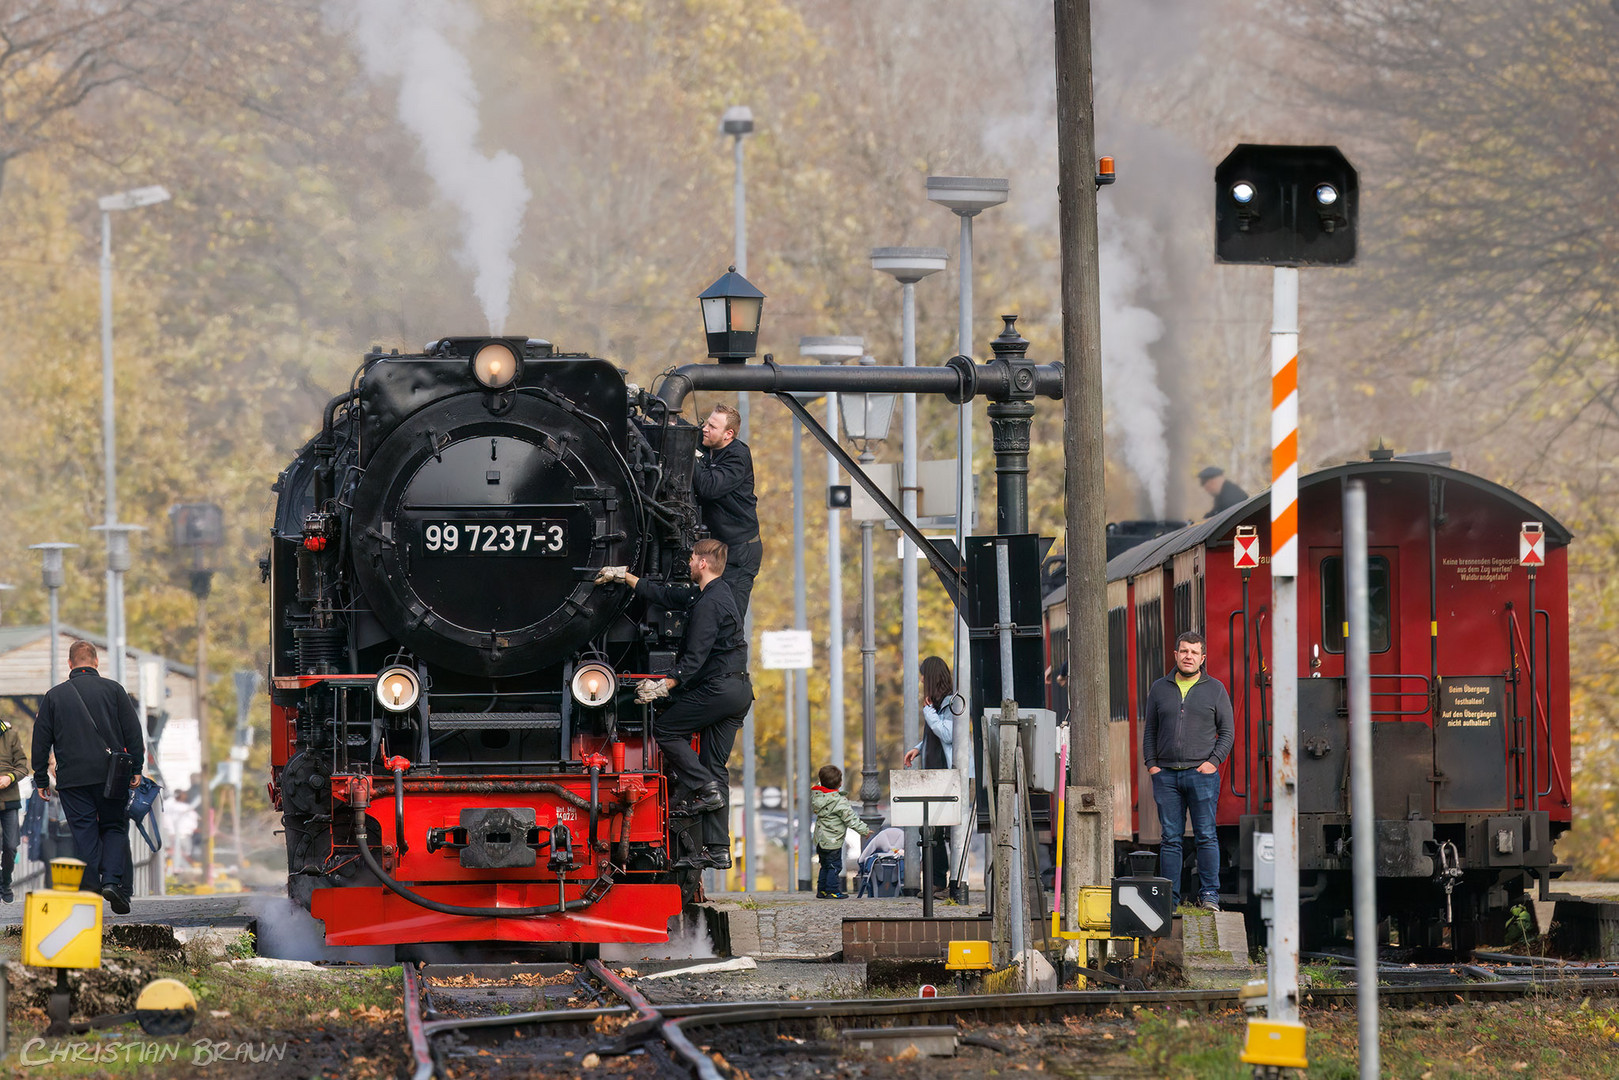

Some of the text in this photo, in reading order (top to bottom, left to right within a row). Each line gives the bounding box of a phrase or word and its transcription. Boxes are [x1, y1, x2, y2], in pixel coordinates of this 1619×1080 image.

[425, 525, 564, 551] 99 7237-3
[1480, 566, 1490, 574] Zug
[1460, 573, 1509, 582] Waldbrandgefahr!
[1448, 684, 1490, 694] Beim Übergang
[1464, 709, 1497, 719] Übergängen
[1447, 719, 1491, 727] nicht aufhalten!
[1152, 886, 1159, 896] 5
[42, 902, 49, 915] 4
